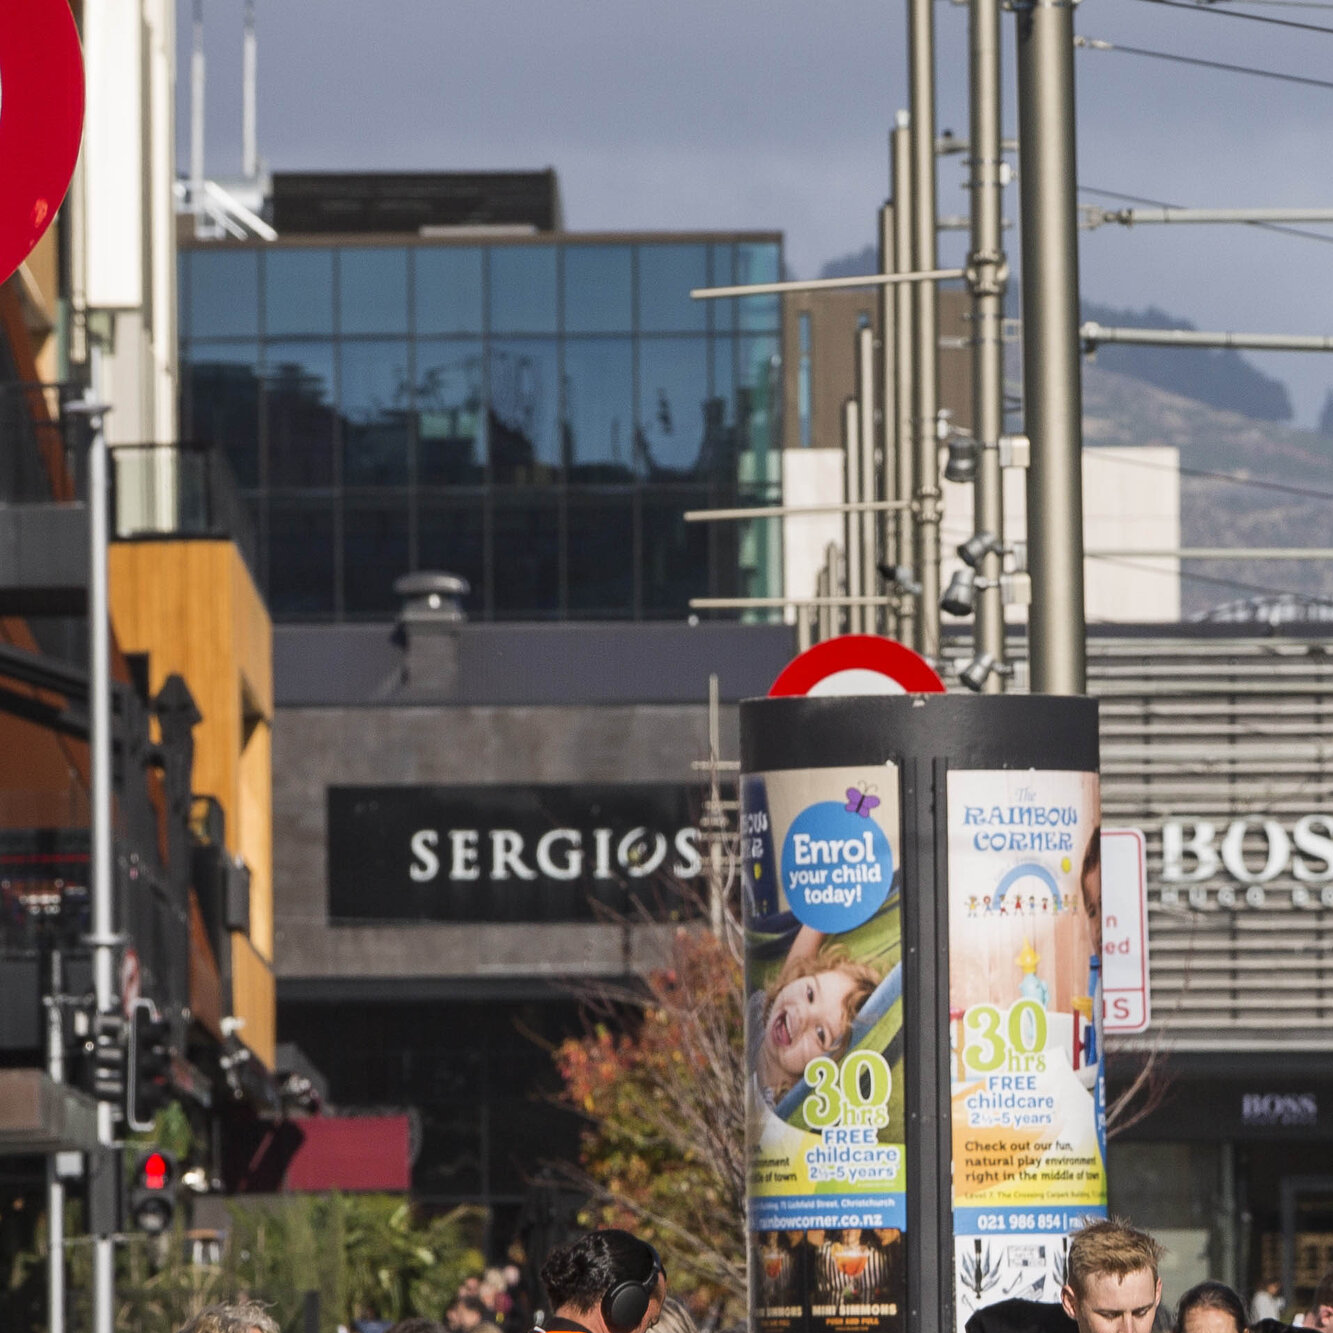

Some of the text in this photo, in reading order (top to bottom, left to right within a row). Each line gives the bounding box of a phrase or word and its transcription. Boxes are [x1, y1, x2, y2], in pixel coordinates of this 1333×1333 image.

[962, 805, 1078, 826] RAINBOW
[793, 831, 876, 865] Enrol
[973, 832, 1073, 852] CORNER
[409, 827, 702, 881] SERGIOS
[789, 863, 882, 889] your child
[804, 884, 863, 908] today!
[966, 1000, 1047, 1072] 30
[1007, 1048, 1047, 1073] hrs
[804, 1051, 891, 1128] 30
[989, 1076, 1038, 1091] FREE
[966, 1092, 1054, 1110] childcare
[842, 1102, 889, 1128] hrs
[824, 1128, 875, 1145] FREE
[965, 1139, 1074, 1152] Check out our fun,
[806, 1146, 898, 1164] childcare
[965, 1155, 1097, 1169] natural play environment
[965, 1170, 999, 1184] right
[1003, 1170, 1015, 1181] in
[1019, 1170, 1038, 1181] the
[1041, 1170, 1074, 1180] middle
[977, 1214, 1006, 1231] 021
[1008, 1213, 1036, 1230] 986
[1037, 1213, 1061, 1230] 854
